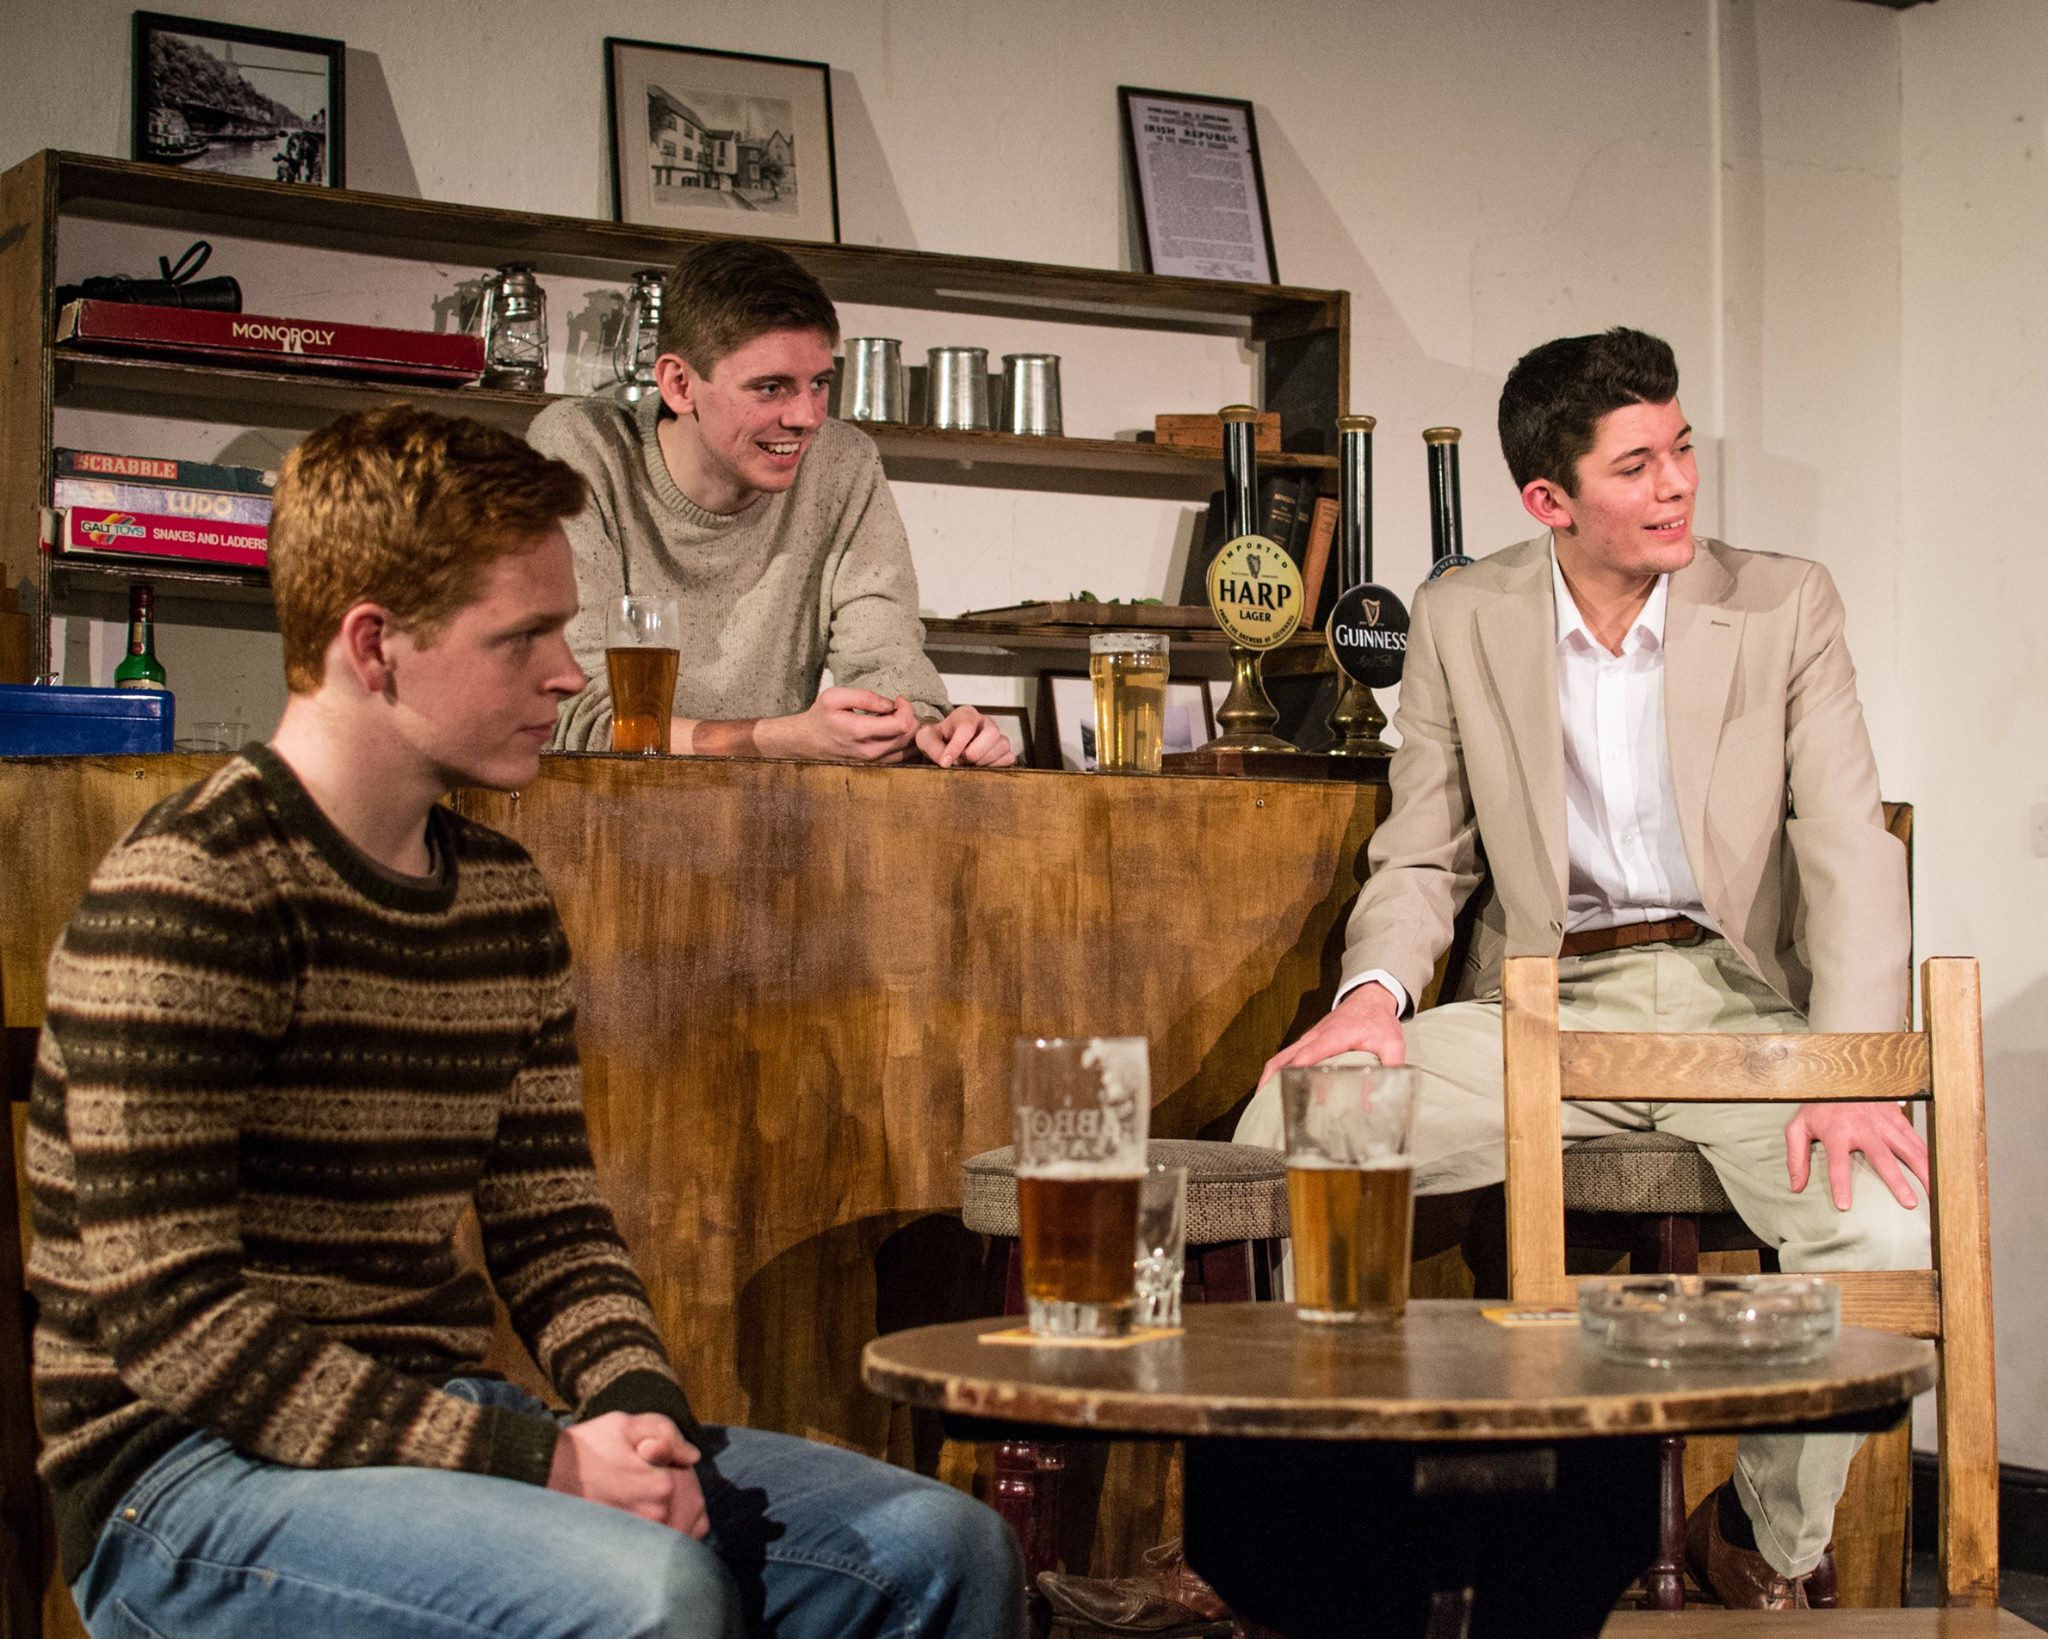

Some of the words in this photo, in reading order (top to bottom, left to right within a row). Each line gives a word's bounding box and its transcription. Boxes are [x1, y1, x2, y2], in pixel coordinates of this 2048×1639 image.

[1144, 124, 1176, 135] IRISH
[1184, 130, 1239, 144] REPUBLIC
[232, 322, 336, 346] MONOPOLY
[79, 455, 176, 478] SCRABBLE
[167, 491, 234, 516] LUDO
[81, 521, 111, 533] GALT
[113, 525, 145, 537] TOYS
[153, 528, 196, 543] SNAKES
[197, 532, 219, 545] AND
[220, 535, 268, 550] LADDERS
[1221, 542, 1288, 569] IMPORTED
[1220, 579, 1292, 610] HARP
[1239, 610, 1272, 622] LAGER
[1229, 624, 1239, 635] THE
[1239, 632, 1263, 643] BREWERS
[1272, 615, 1295, 639] GUINNESS
[1335, 624, 1407, 651] GUINNESS
